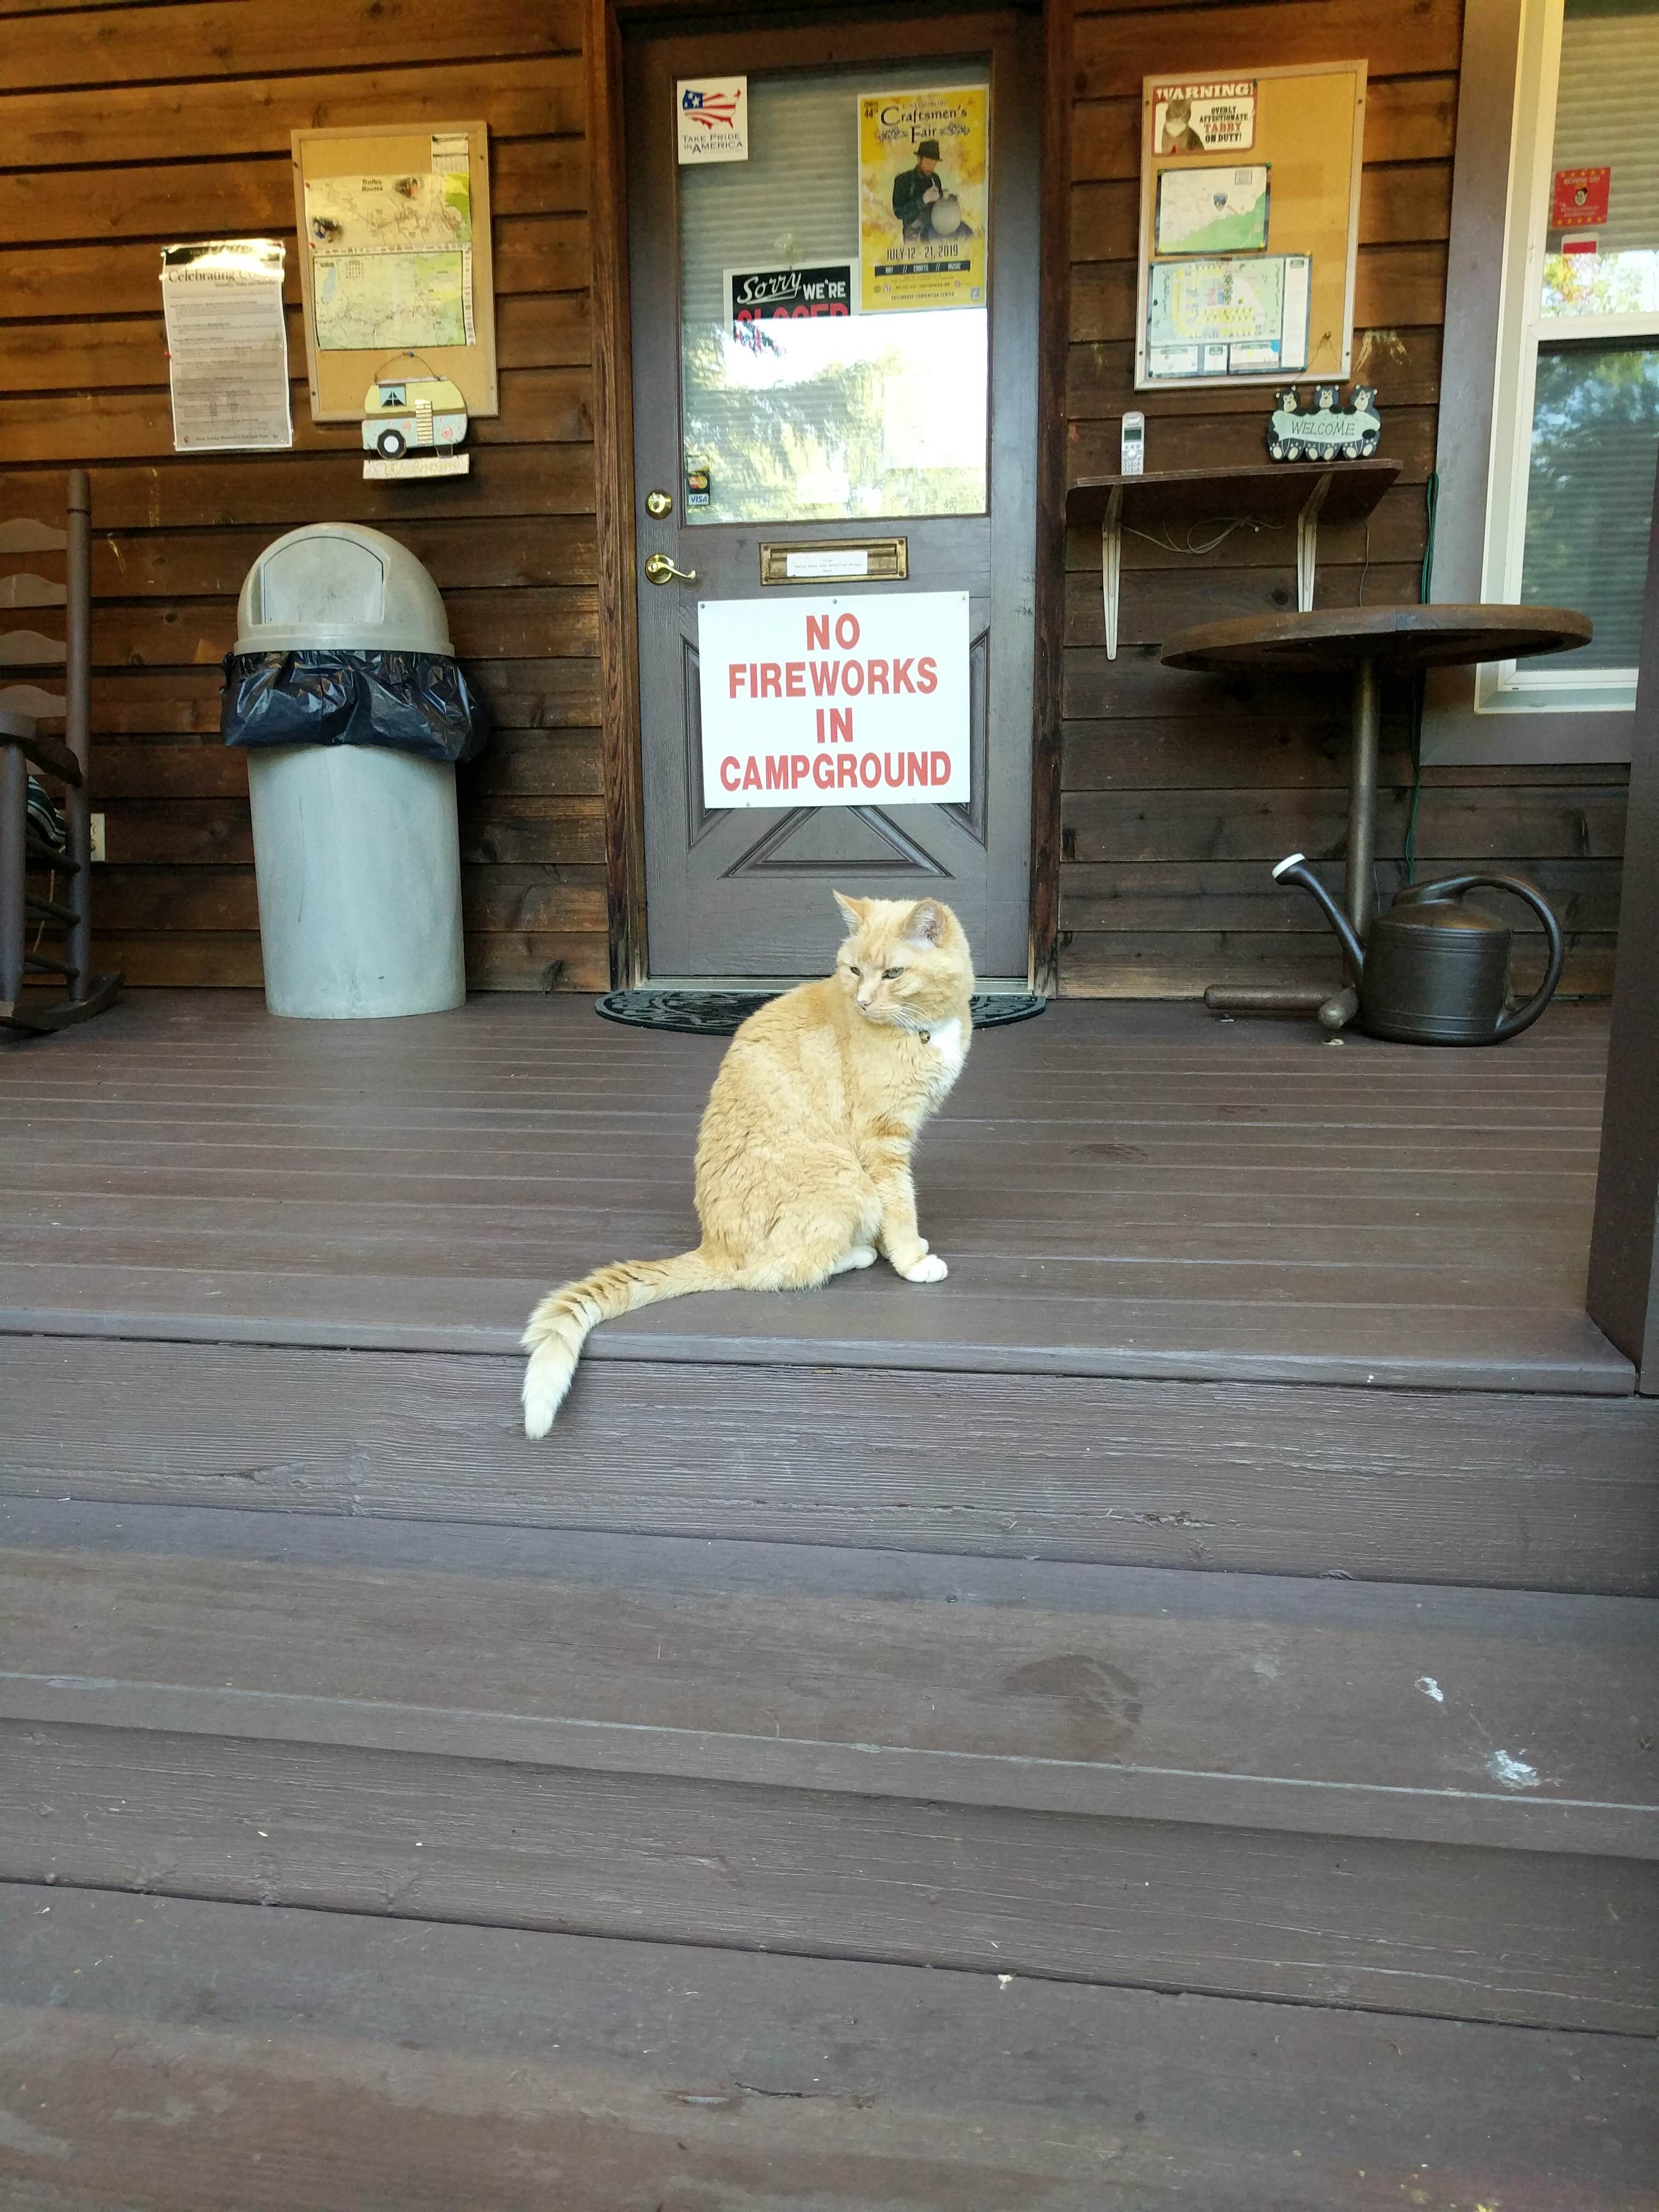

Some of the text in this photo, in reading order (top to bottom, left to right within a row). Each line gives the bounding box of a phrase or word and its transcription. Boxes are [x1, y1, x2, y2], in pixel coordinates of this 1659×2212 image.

[1156, 83, 1254, 101] WARNING!
[881, 104, 967, 126] Craftsmen's
[1199, 113, 1248, 123] AFFECTIONATE
[1211, 106, 1236, 115] OVERLY
[911, 125, 936, 144] Fair
[1204, 122, 1242, 133] TABBY
[710, 133, 740, 141] PRIDE
[1205, 133, 1242, 143] ON DUTY!
[692, 141, 743, 154] AMERICA
[887, 248, 904, 260] JULY
[908, 247, 916, 259] 12
[938, 244, 958, 258] 2019
[913, 264, 928, 273] CRAFTS
[948, 262, 961, 270] MUSIC
[737, 272, 846, 304] Sorry WE'RE
[1292, 421, 1355, 436] WELCOME
[806, 613, 860, 651] NO
[729, 657, 938, 699] FIREWORKS
[816, 707, 853, 744] IN
[720, 751, 951, 792] CAMPGROUND
